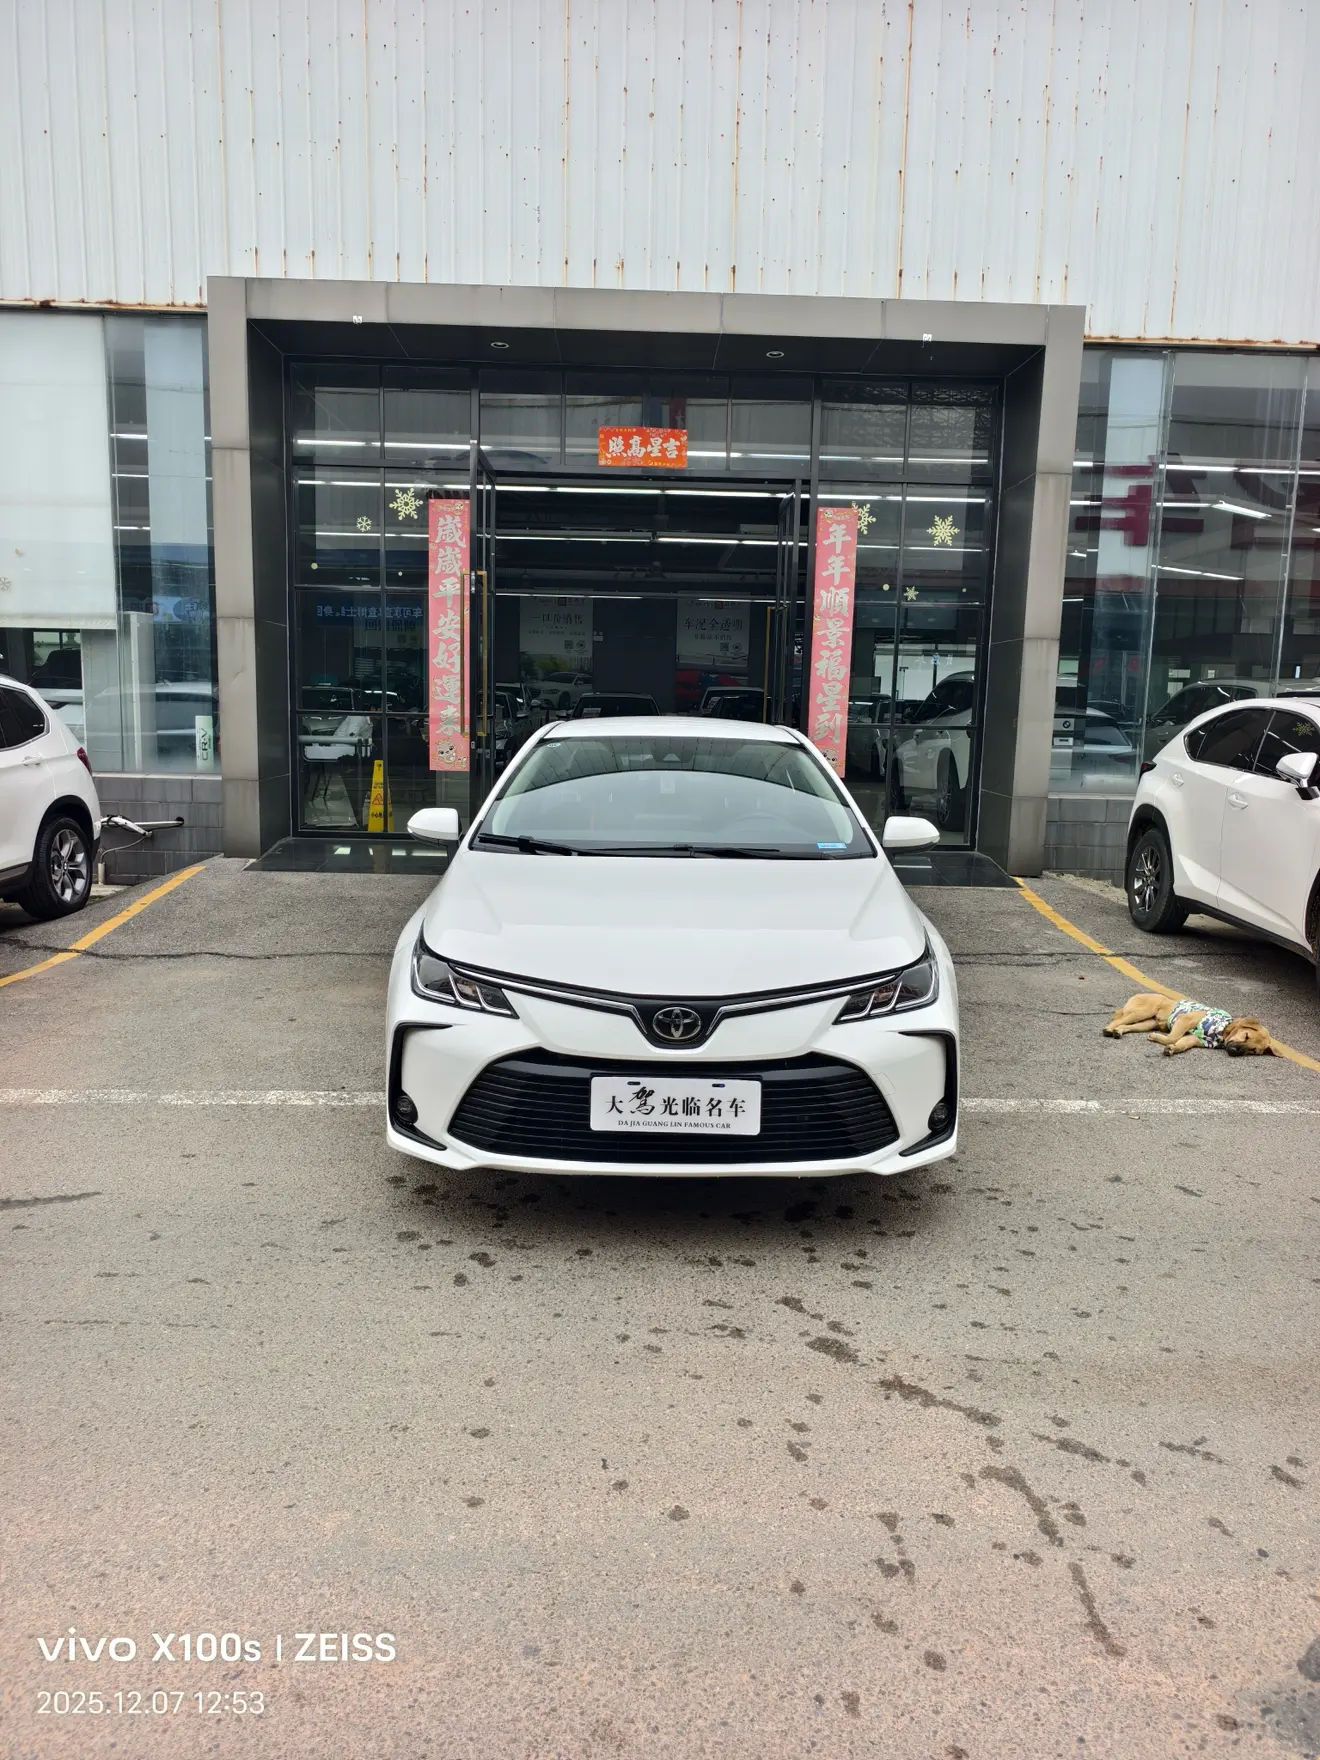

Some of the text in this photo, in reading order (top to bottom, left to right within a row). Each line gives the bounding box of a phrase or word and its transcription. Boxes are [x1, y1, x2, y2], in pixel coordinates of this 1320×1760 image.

[684, 617, 744, 632] 车况全透明
